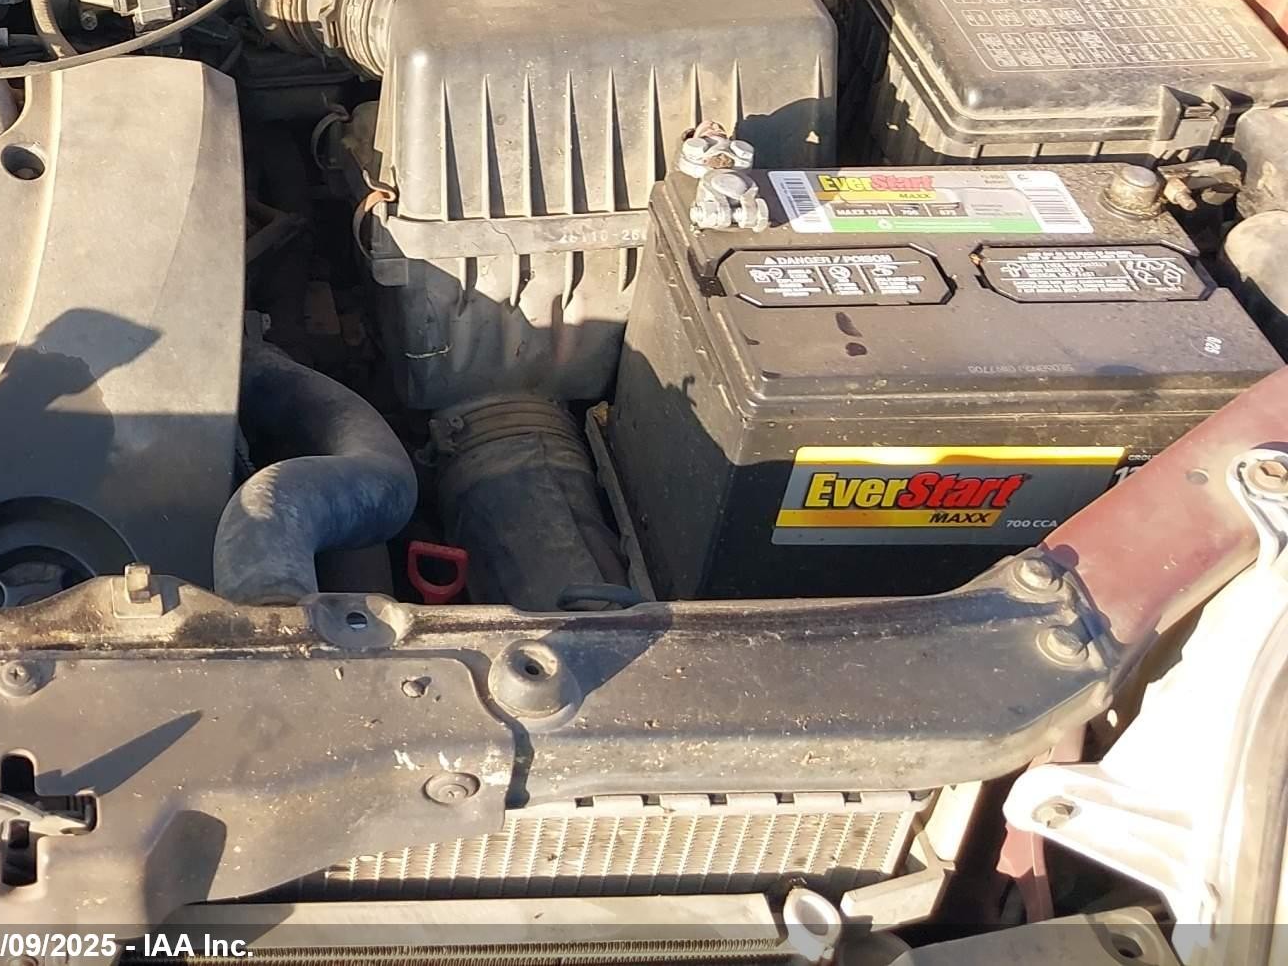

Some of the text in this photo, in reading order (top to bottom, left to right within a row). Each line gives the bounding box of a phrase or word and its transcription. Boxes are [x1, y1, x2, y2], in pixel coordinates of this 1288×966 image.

[818, 174, 934, 192] EverStart
[777, 256, 832, 265] DANGER
[842, 254, 894, 264] POISON
[802, 471, 1026, 510] EverStart
[929, 511, 992, 524] MAXX
[1006, 519, 1057, 529] 700 CCA
